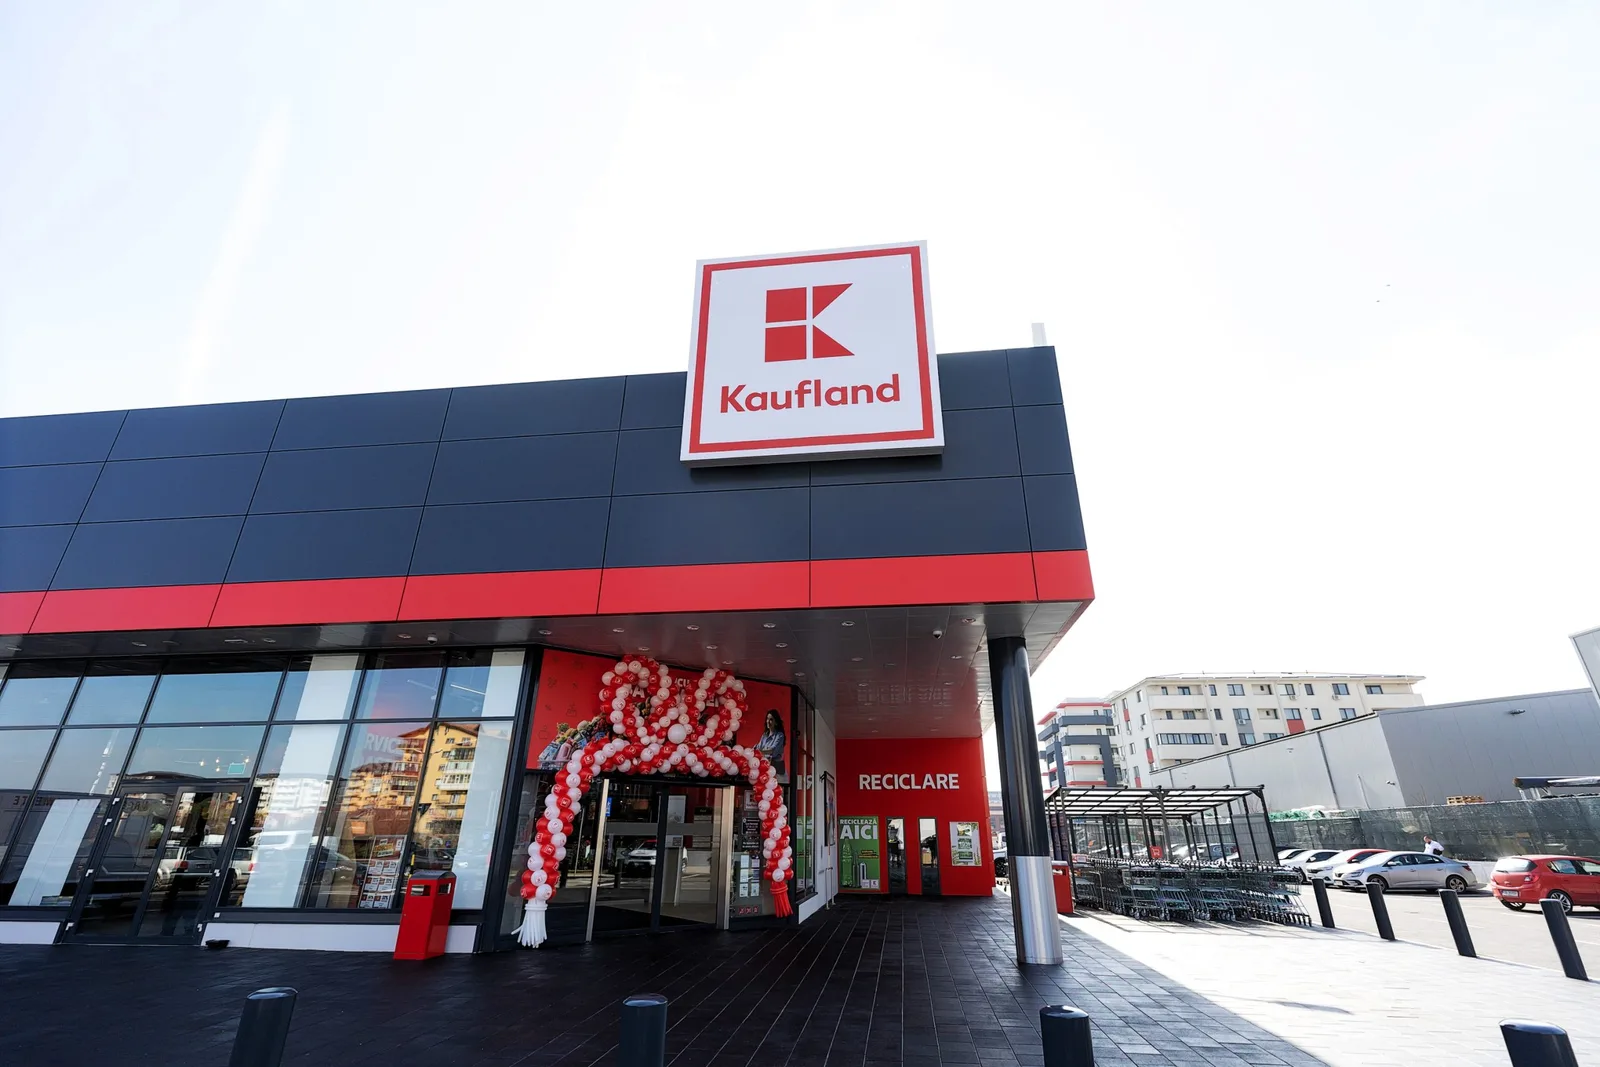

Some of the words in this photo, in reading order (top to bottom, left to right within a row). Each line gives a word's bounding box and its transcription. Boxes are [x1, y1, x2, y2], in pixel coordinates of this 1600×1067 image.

[720, 373, 900, 413] Kaufland
[859, 773, 960, 790] RECICLARE
[840, 825, 878, 839] AICI
